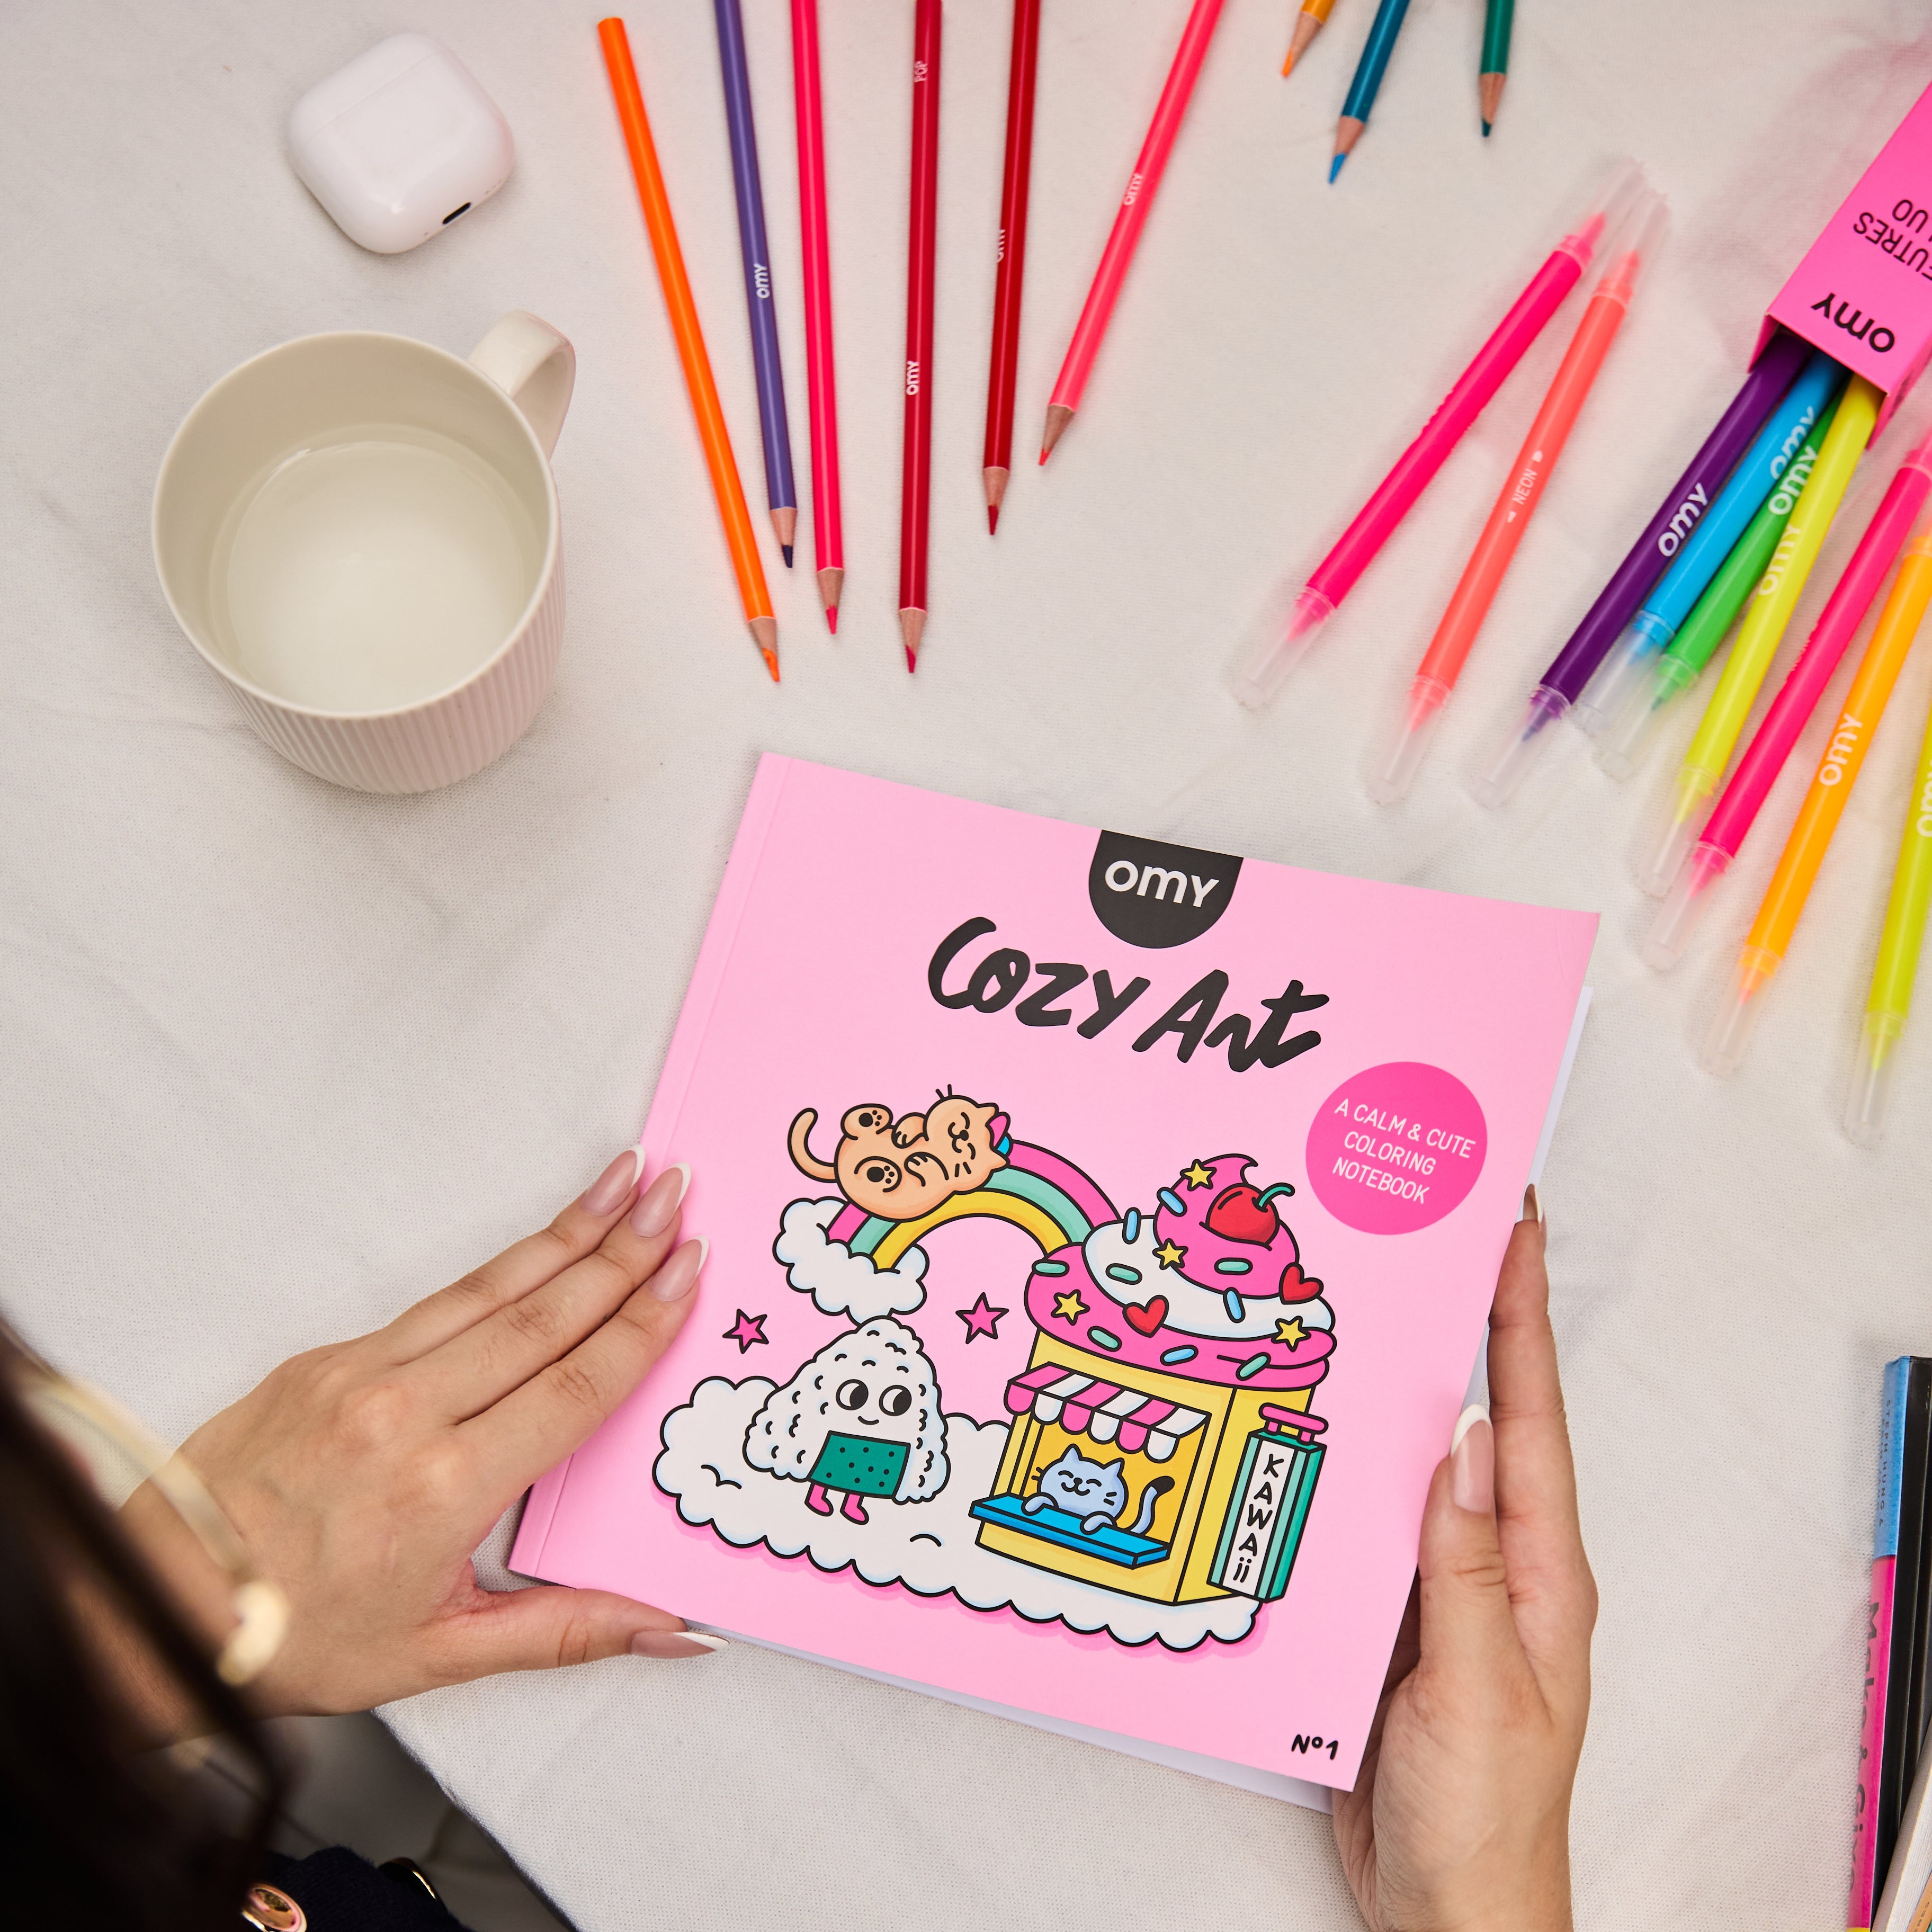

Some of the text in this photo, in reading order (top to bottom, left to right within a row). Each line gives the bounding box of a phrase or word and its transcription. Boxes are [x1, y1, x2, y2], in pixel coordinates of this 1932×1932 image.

[1123, 173, 1144, 205] omy
[1892, 200, 1932, 242] UO
[753, 262, 770, 299] omy
[1810, 292, 1895, 353] omy
[906, 360, 920, 396] omy
[1511, 468, 1538, 505] NEON
[1768, 445, 1818, 515] omy
[1658, 482, 1708, 557] omy
[1758, 523, 1801, 596] omy
[1819, 713, 1863, 786] omy
[1104, 860, 1220, 908] omy
[1131, 969, 1330, 1072] Art
[1334, 1098, 1476, 1158] A CALM & CUTE
[1344, 1131, 1436, 1175] COLORING
[1332, 1157, 1430, 1204] NOTEBOOK
